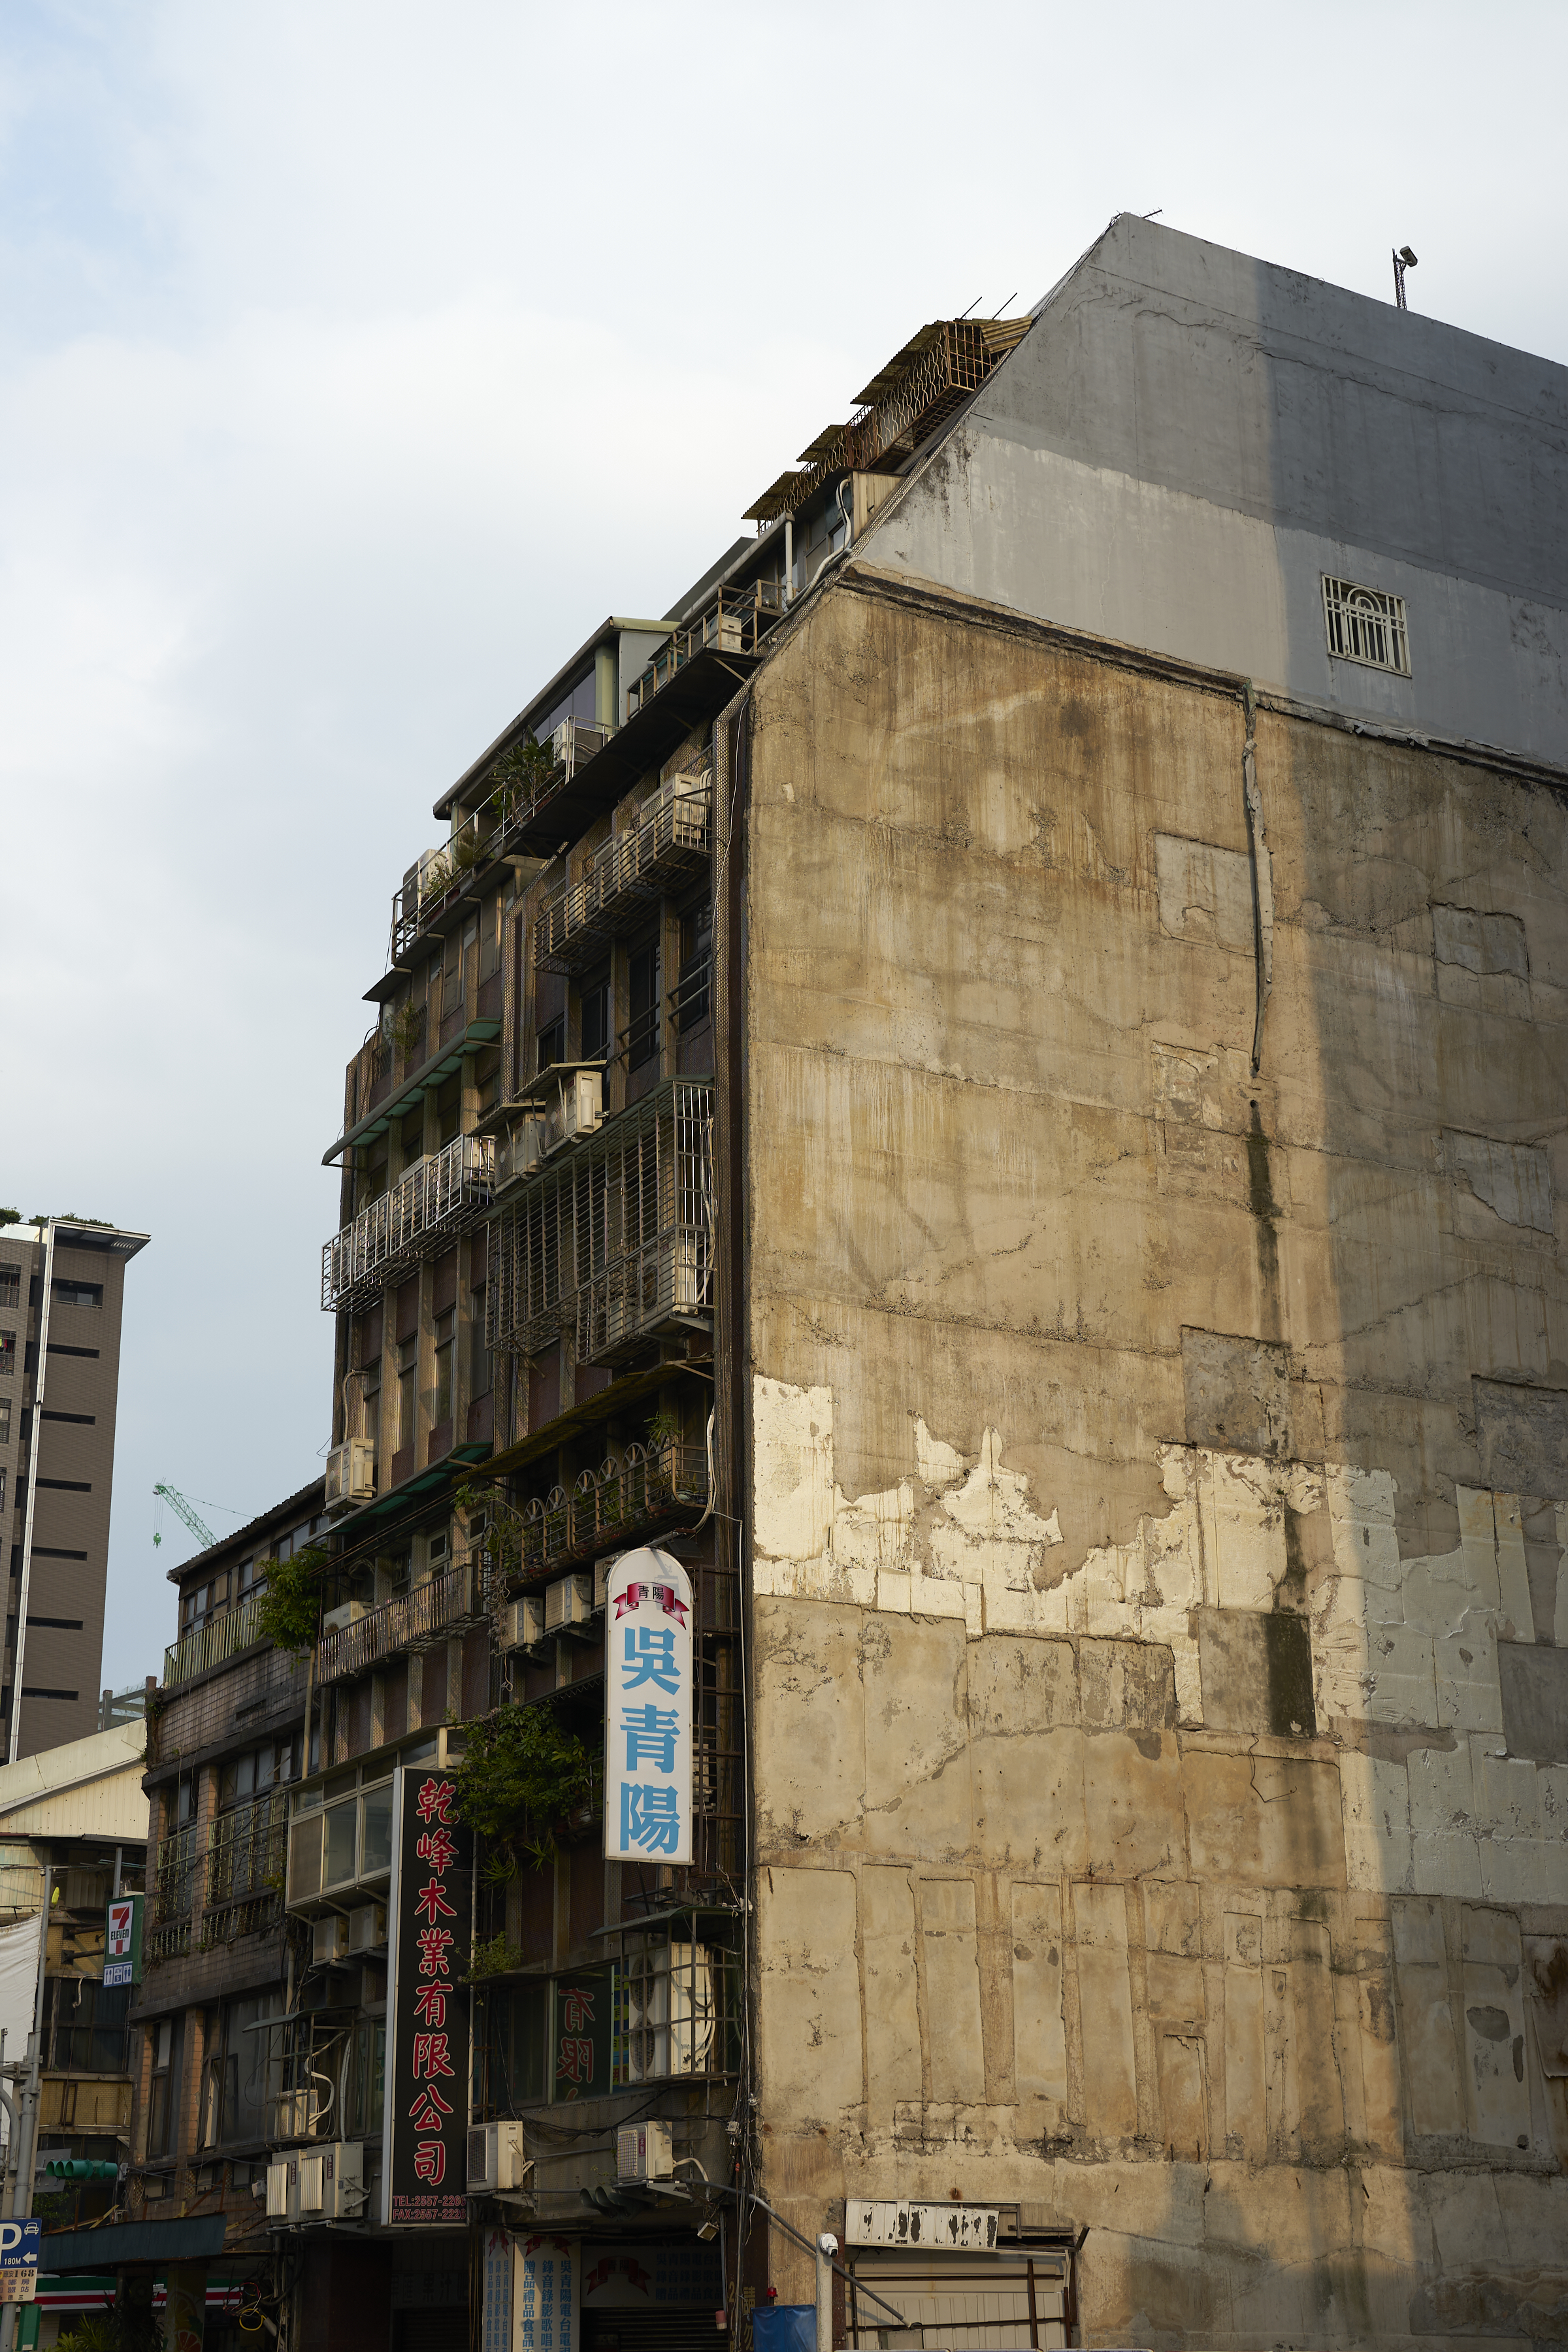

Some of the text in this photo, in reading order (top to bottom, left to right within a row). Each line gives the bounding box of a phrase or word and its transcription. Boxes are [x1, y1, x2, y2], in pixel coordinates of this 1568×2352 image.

[637, 1584, 664, 1601] 青陽
[620, 1626, 681, 1854] 吳青陽
[409, 1778, 459, 2185] 乾峰木業有限公司
[393, 2195, 466, 2207] TEL:2557-2266
[393, 2208, 466, 2220] FAX:2557-2226
[0, 2223, 22, 2265] P
[607, 2259, 630, 2272] 青陽
